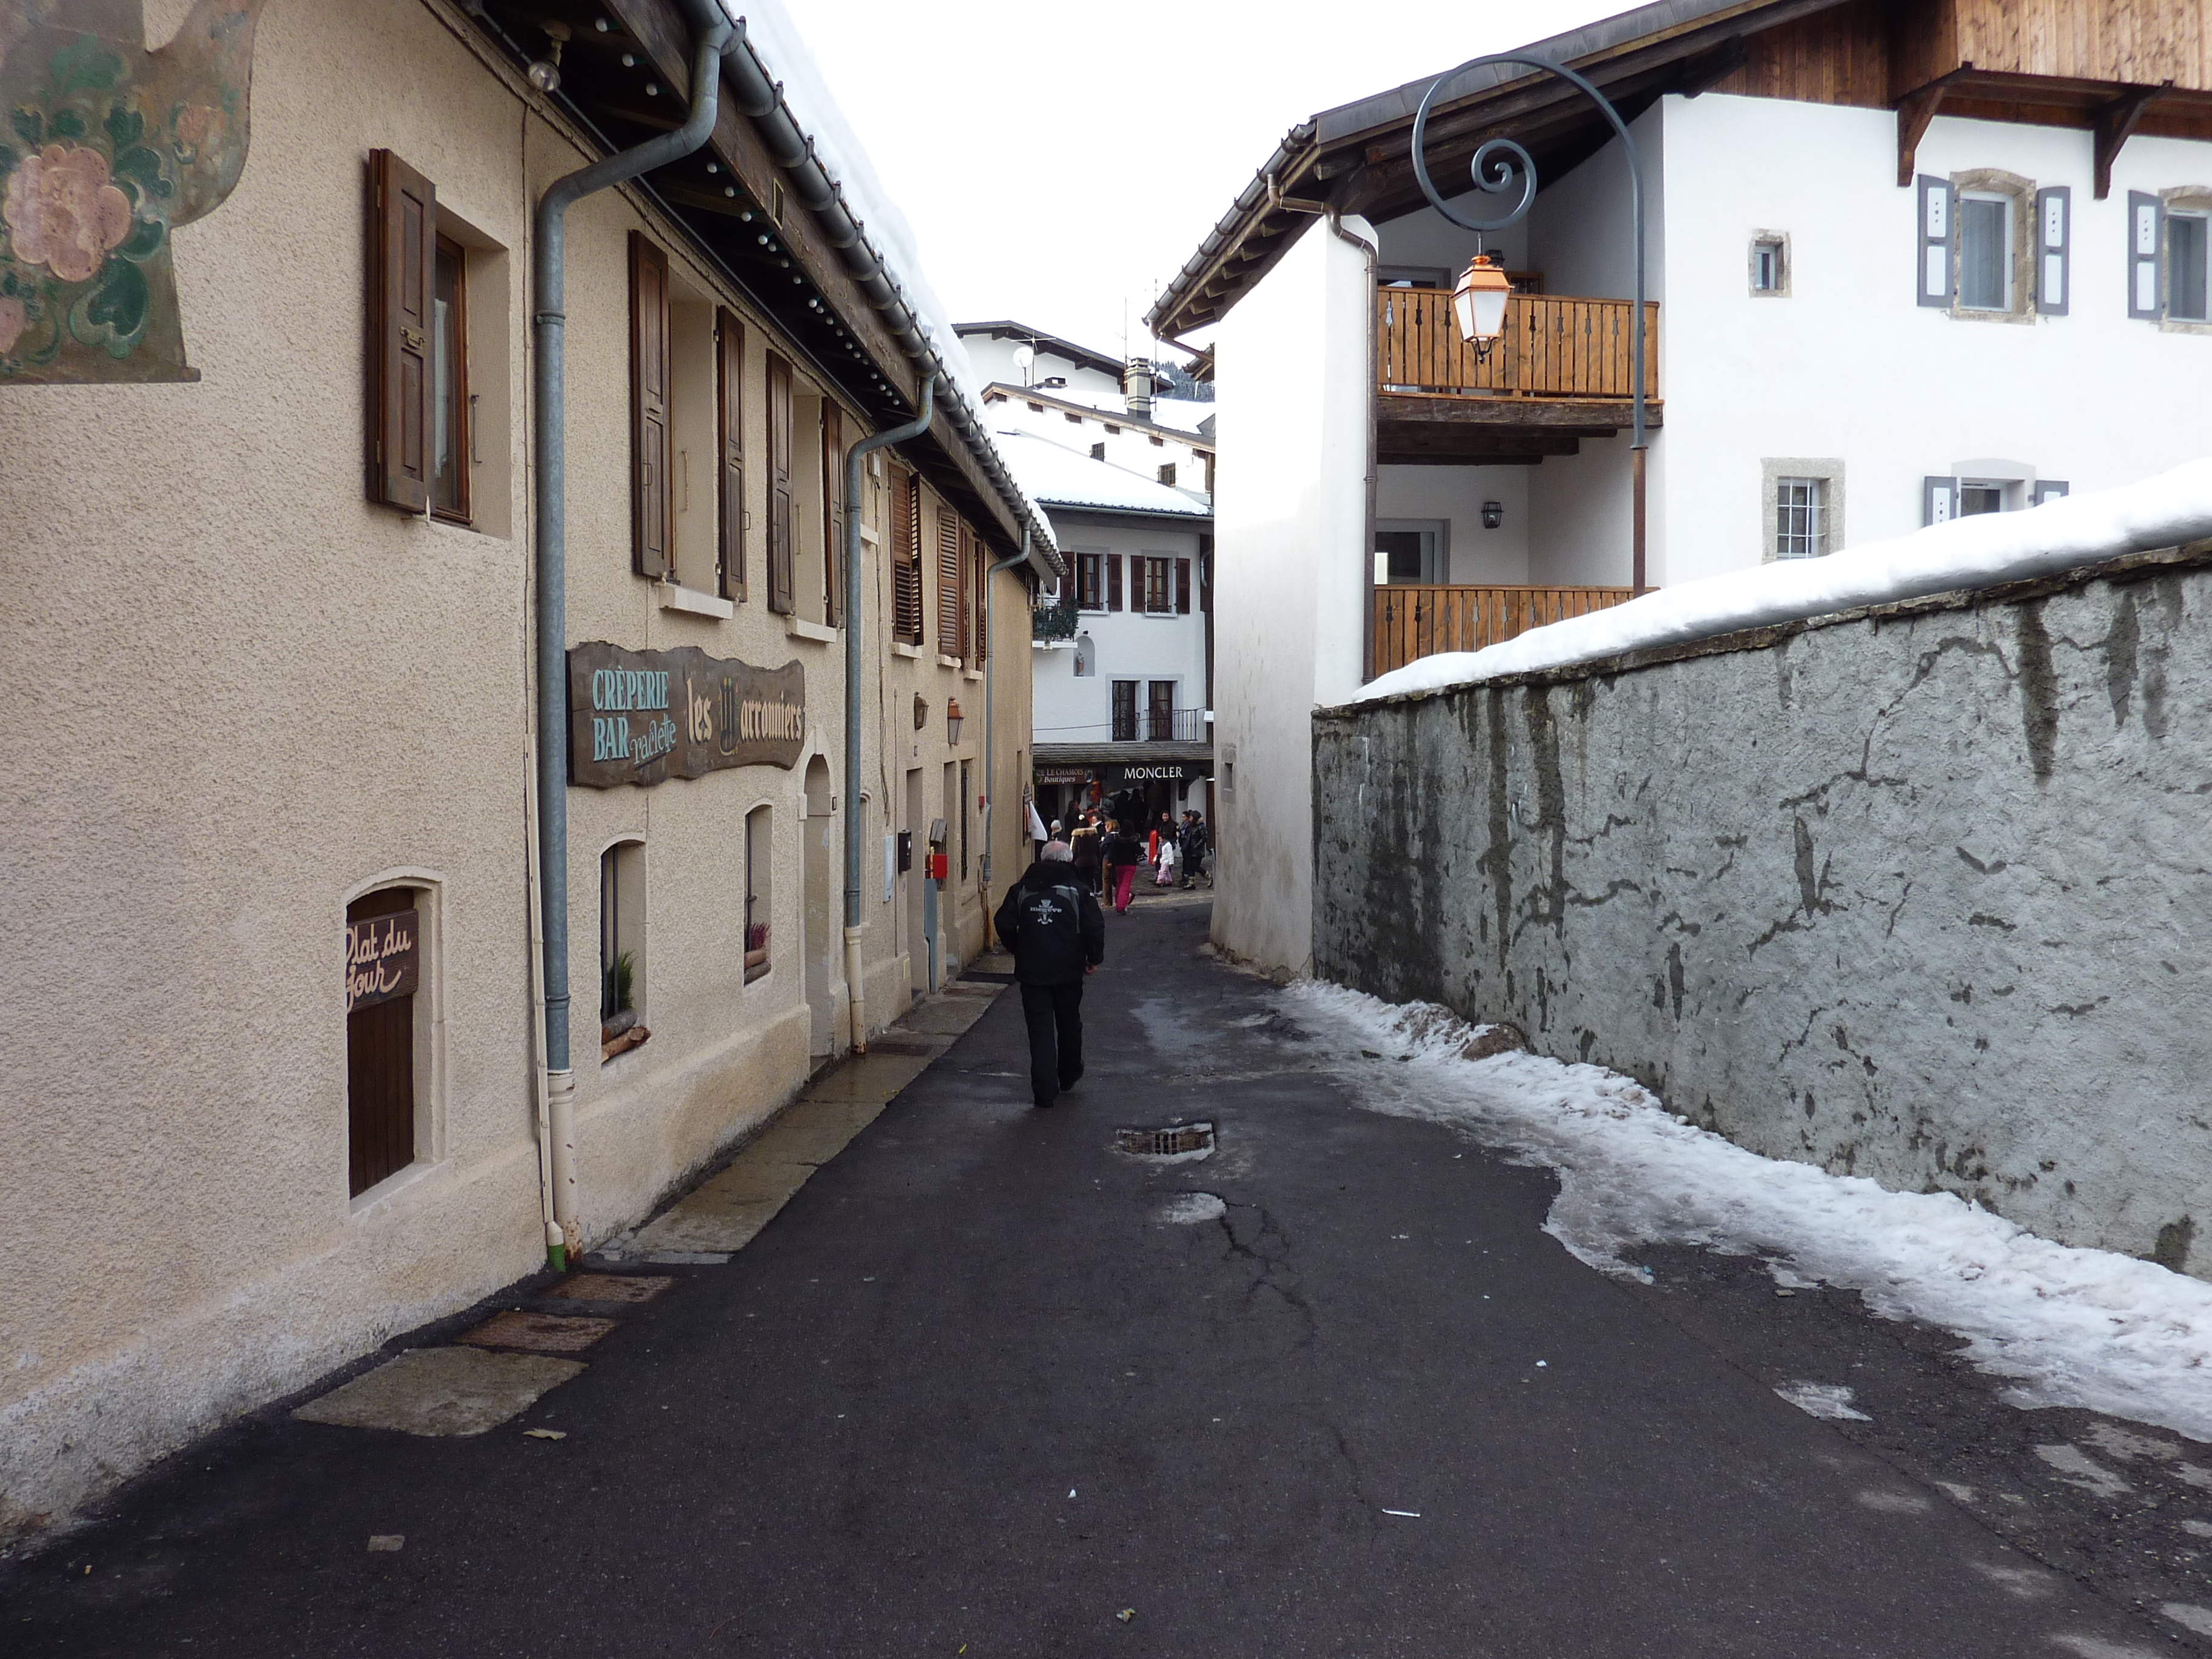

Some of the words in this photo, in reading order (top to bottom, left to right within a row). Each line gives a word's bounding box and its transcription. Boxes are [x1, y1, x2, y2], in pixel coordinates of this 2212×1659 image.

[592, 665, 669, 711] CRÊPERIE
[686, 677, 712, 743] les
[593, 716, 630, 762] BAR
[630, 712, 677, 765] raclette
[1124, 766, 1184, 780] MONCLER
[381, 919, 412, 959] du
